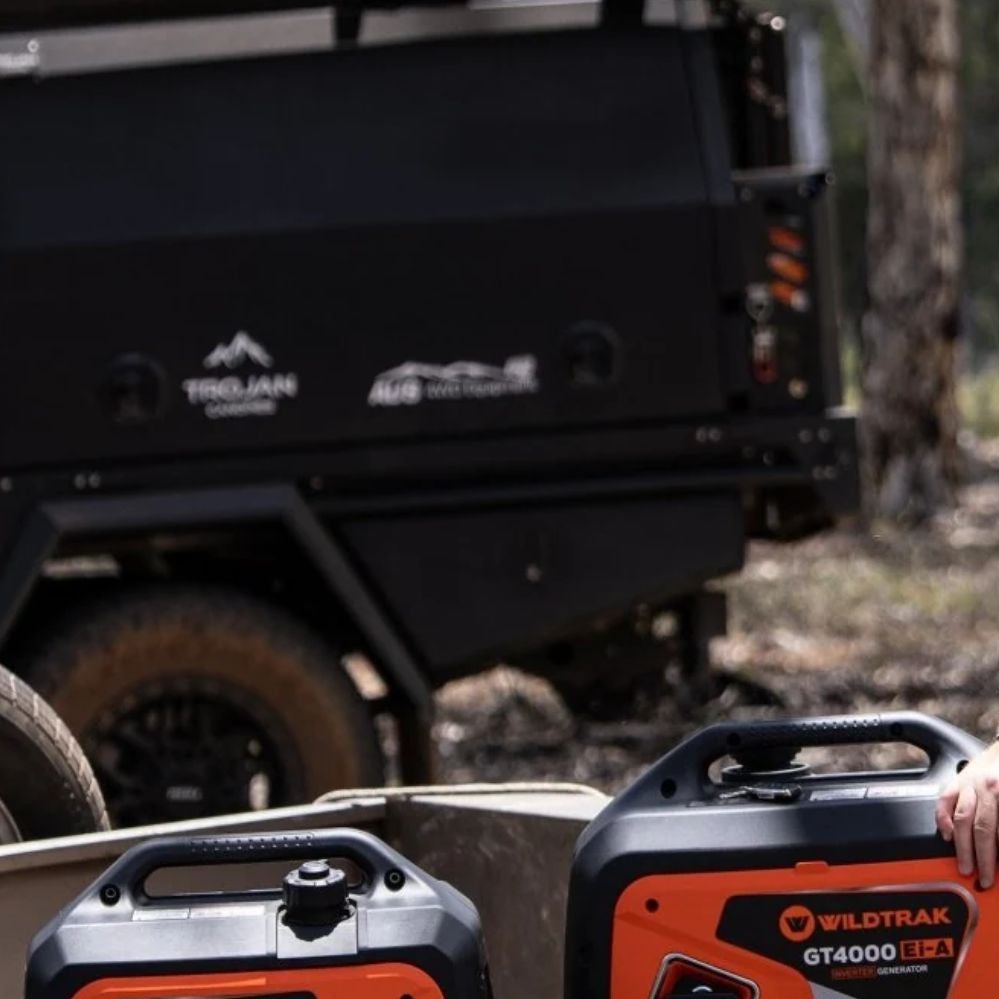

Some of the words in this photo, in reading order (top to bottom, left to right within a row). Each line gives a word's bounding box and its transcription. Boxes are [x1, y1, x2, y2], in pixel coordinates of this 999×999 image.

[182, 373, 298, 405] TROJAN
[817, 908, 951, 931] WILDTRAK
[803, 944, 896, 965] GT4000
[901, 940, 952, 958] Ei-A
[877, 965, 928, 976] GENERATOR
